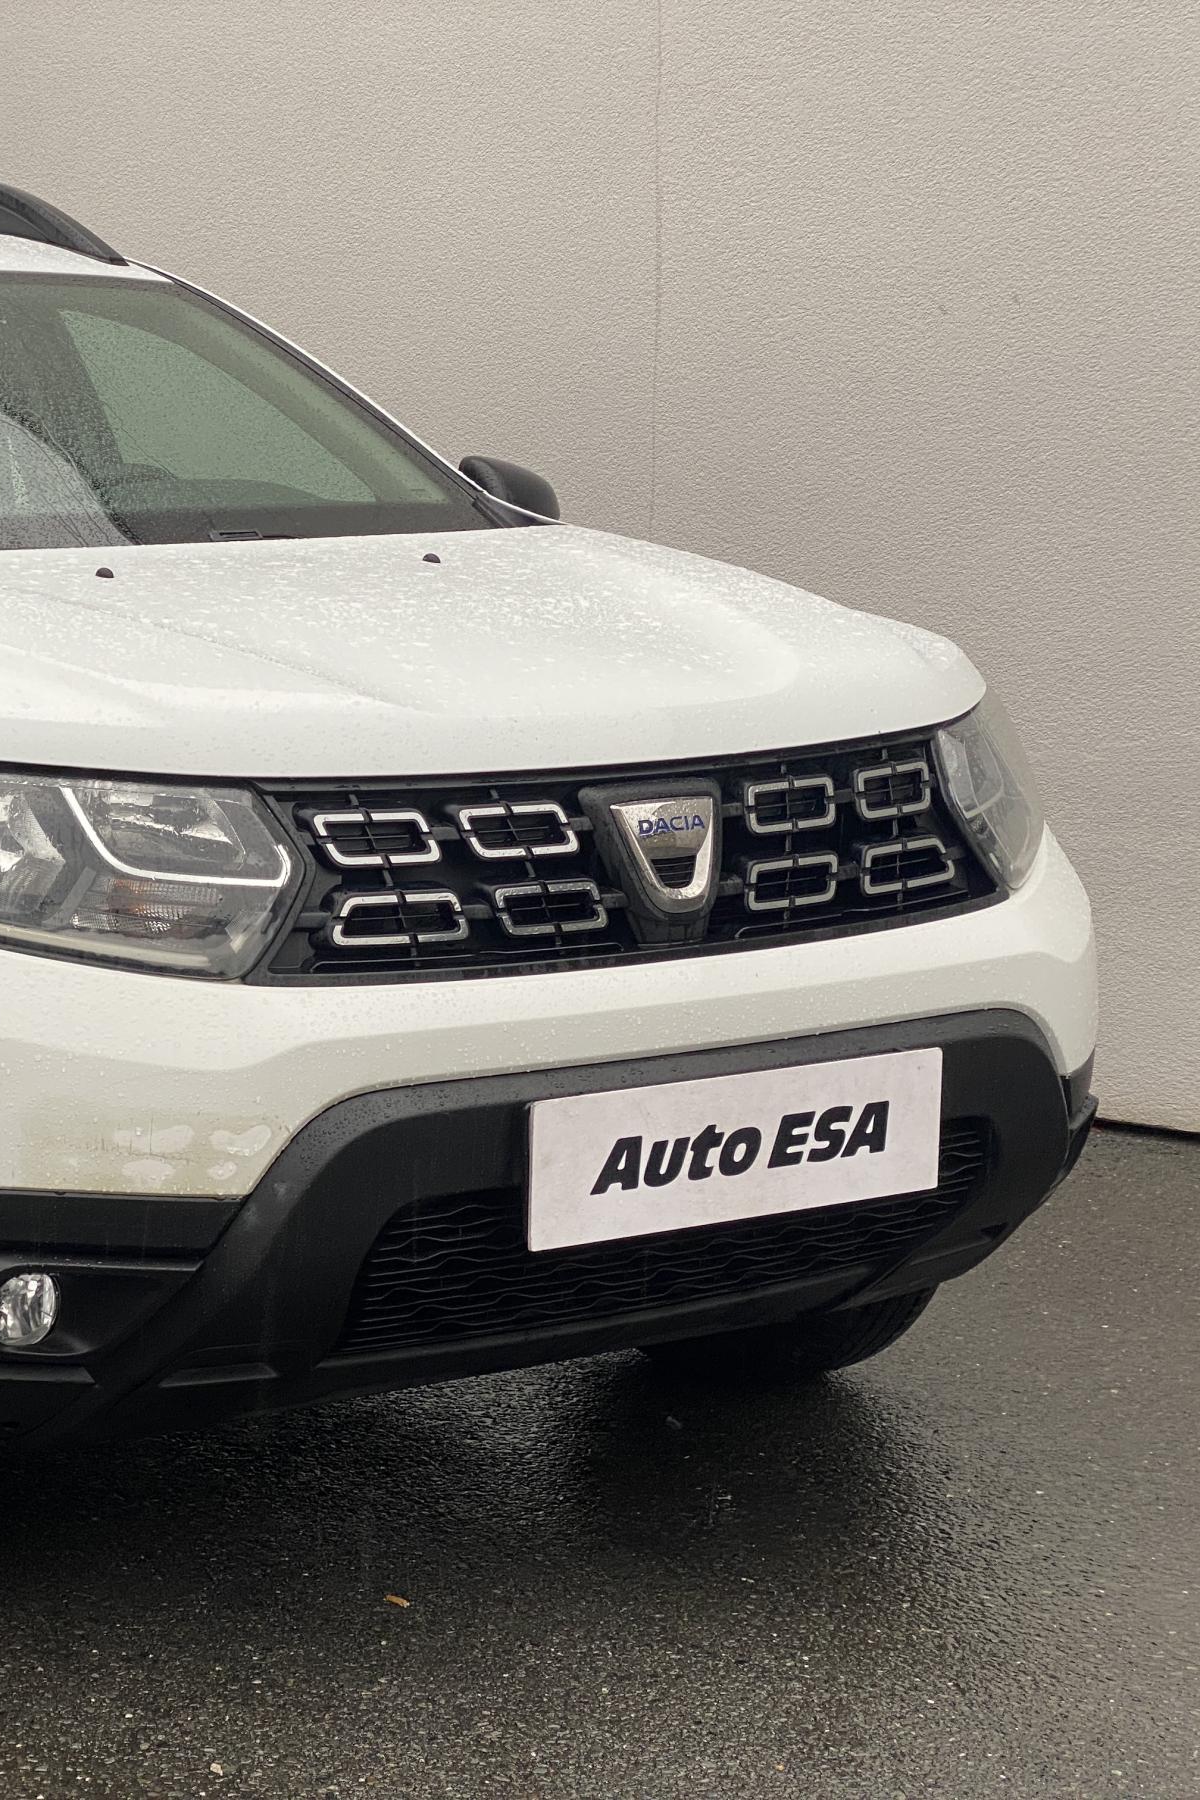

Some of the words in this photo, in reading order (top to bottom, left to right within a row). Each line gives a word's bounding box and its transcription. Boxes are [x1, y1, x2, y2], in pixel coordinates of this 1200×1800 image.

[637, 814, 705, 836] DACIA
[589, 1124, 762, 1196] Auto
[767, 1100, 890, 1169] ESA
